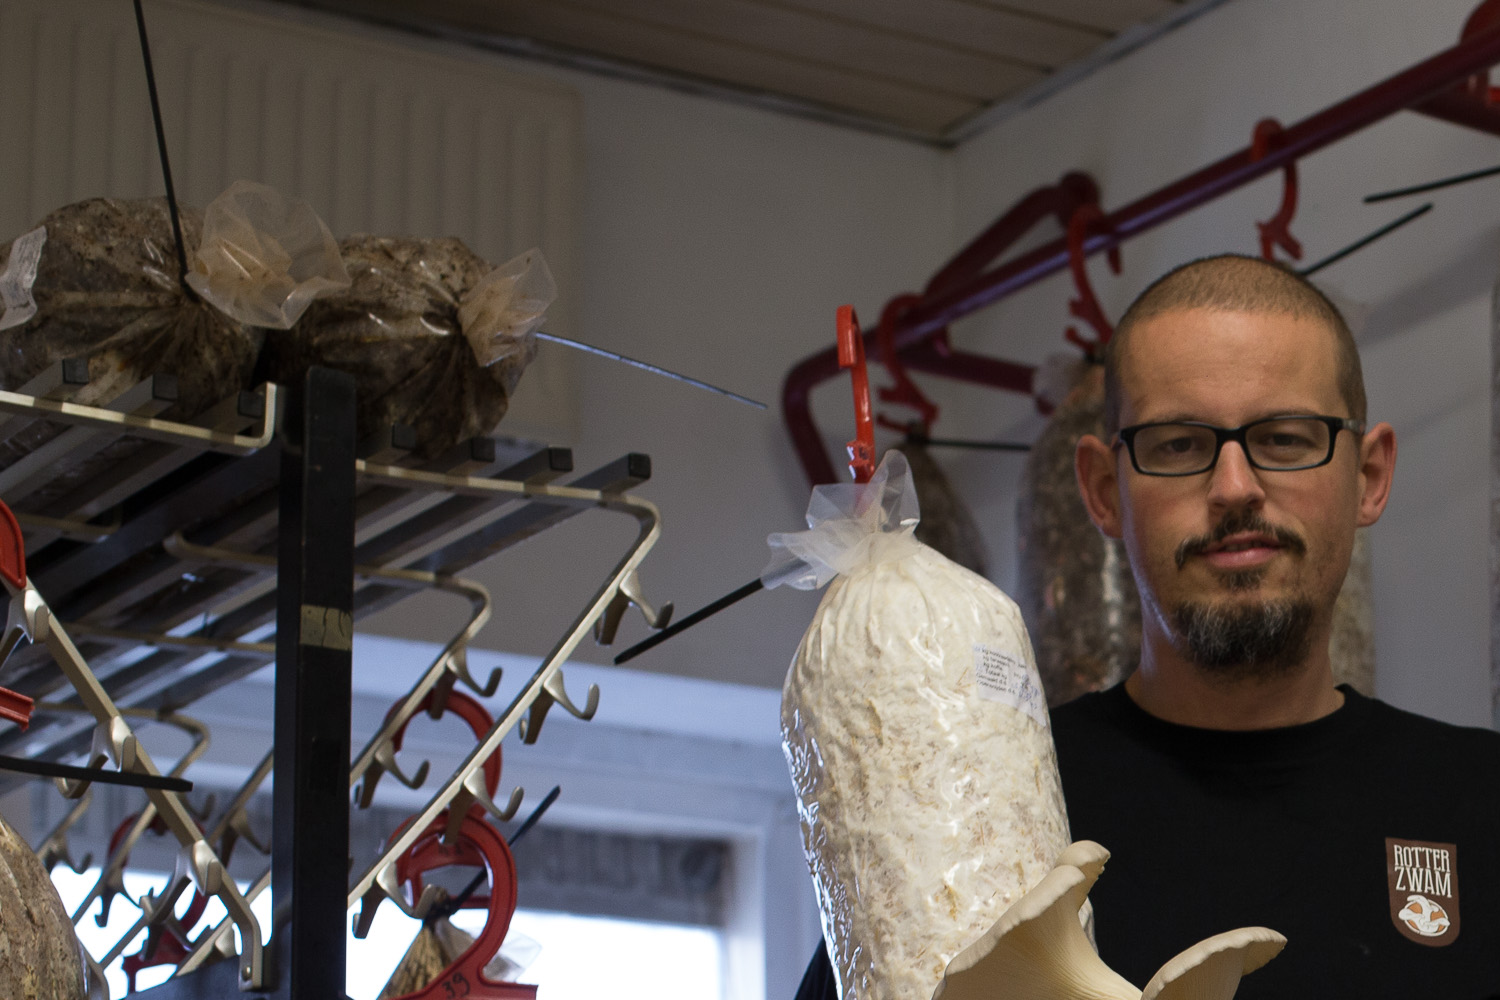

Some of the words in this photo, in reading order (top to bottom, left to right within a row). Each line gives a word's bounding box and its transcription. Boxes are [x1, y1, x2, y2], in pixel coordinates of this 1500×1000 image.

[1393, 844, 1451, 873] ROTTER
[1394, 866, 1452, 899] ZWAM
[441, 972, 471, 1000] 39
